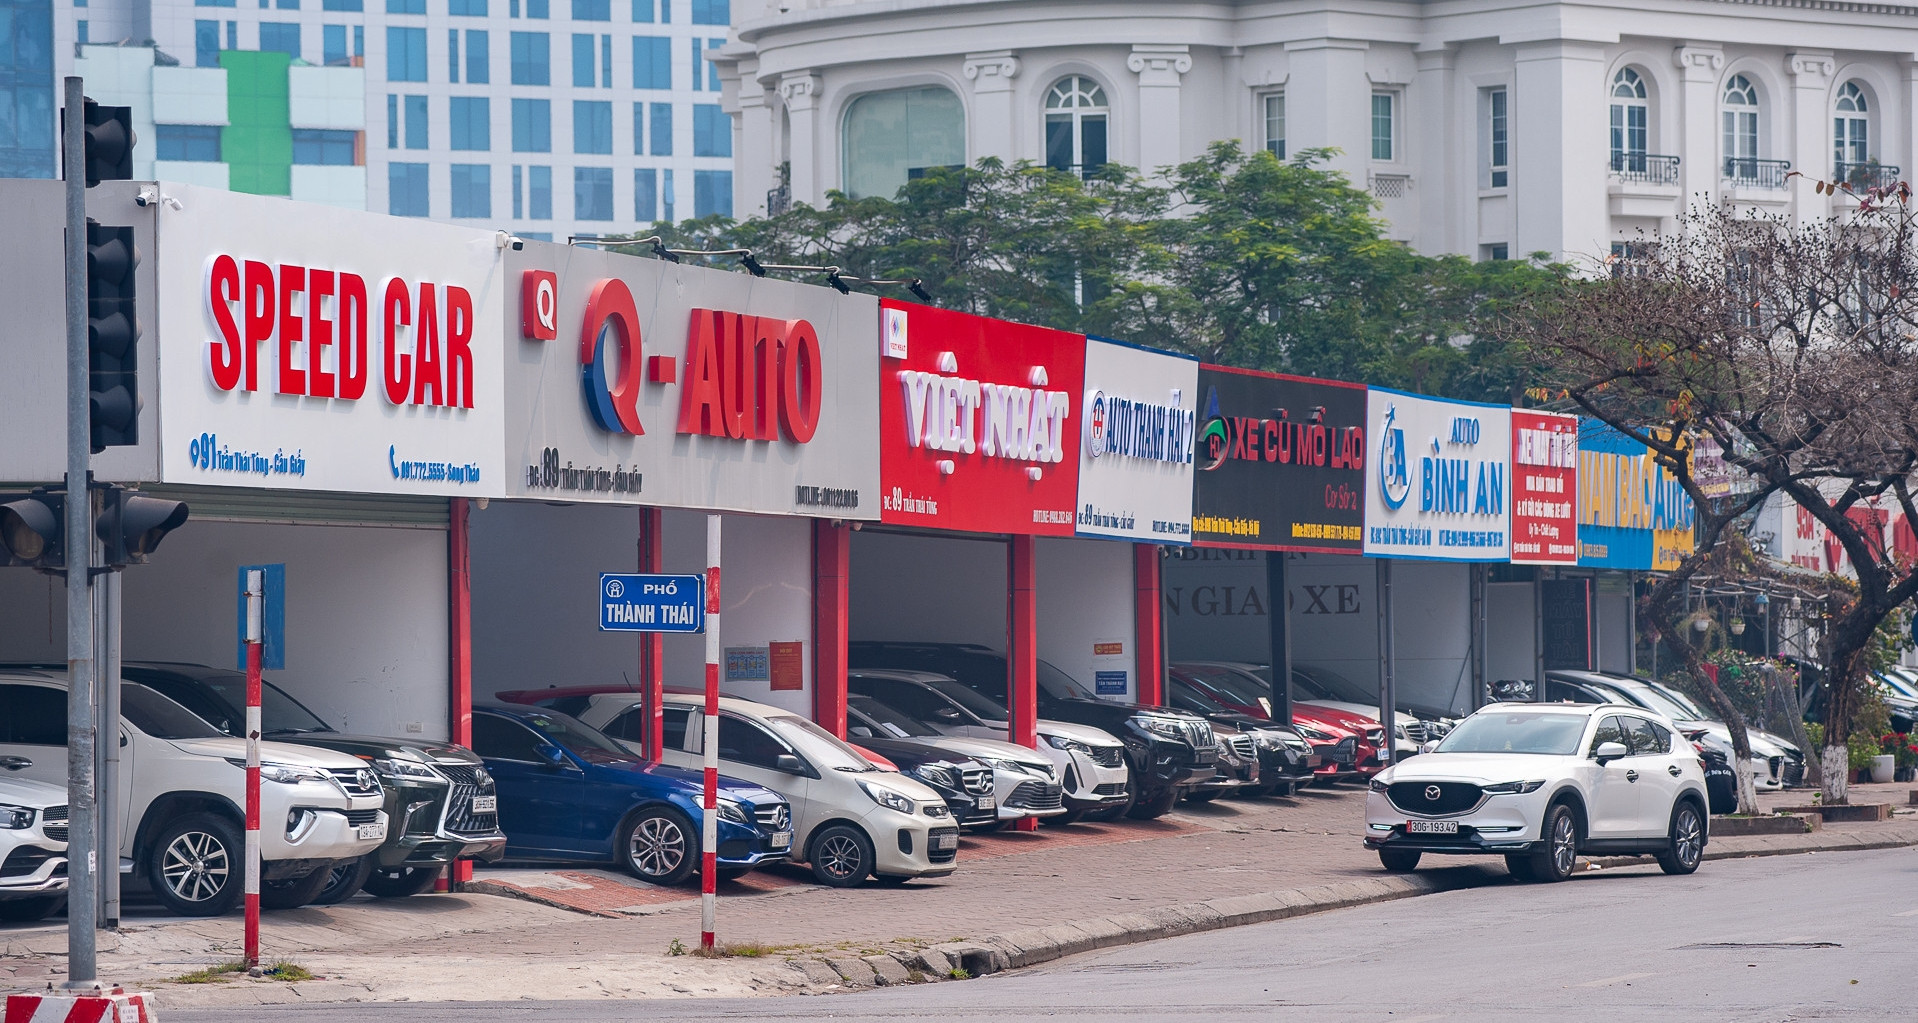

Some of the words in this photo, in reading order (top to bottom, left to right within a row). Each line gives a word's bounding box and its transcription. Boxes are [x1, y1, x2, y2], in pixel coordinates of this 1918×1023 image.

[206, 254, 367, 401] SPEED
[380, 276, 474, 409] CAR
[677, 308, 821, 443] AUTO
[900, 351, 980, 475] VIỆT
[982, 365, 1069, 480] NHẬT
[1105, 396, 1132, 456] AUTO
[1133, 402, 1166, 460] THANH
[1186, 410, 1194, 464] 2
[1450, 416, 1480, 445] AUTO
[200, 432, 216, 470] 91
[217, 444, 233, 470] Trần
[234, 450, 250, 472] Thái
[251, 451, 268, 476] Tông
[274, 447, 288, 473] Cầu
[290, 448, 306, 477] Giấy
[1233, 416, 1258, 461] XE
[1331, 427, 1363, 470] LAO
[1518, 428, 1533, 465] XE
[542, 446, 560, 488] 89
[1420, 437, 1469, 514] BÌNH
[1474, 460, 1503, 515] AN
[892, 486, 902, 511] 89
[1351, 490, 1358, 510] 2
[1580, 450, 1616, 527] NAM
[1084, 503, 1093, 526] 89
[643, 579, 678, 595] PHỐ
[1302, 584, 1361, 615] XE
[606, 600, 655, 624] THÀNH
[660, 601, 694, 625] THÁI
[1412, 821, 1456, 832] 30G-193.42
